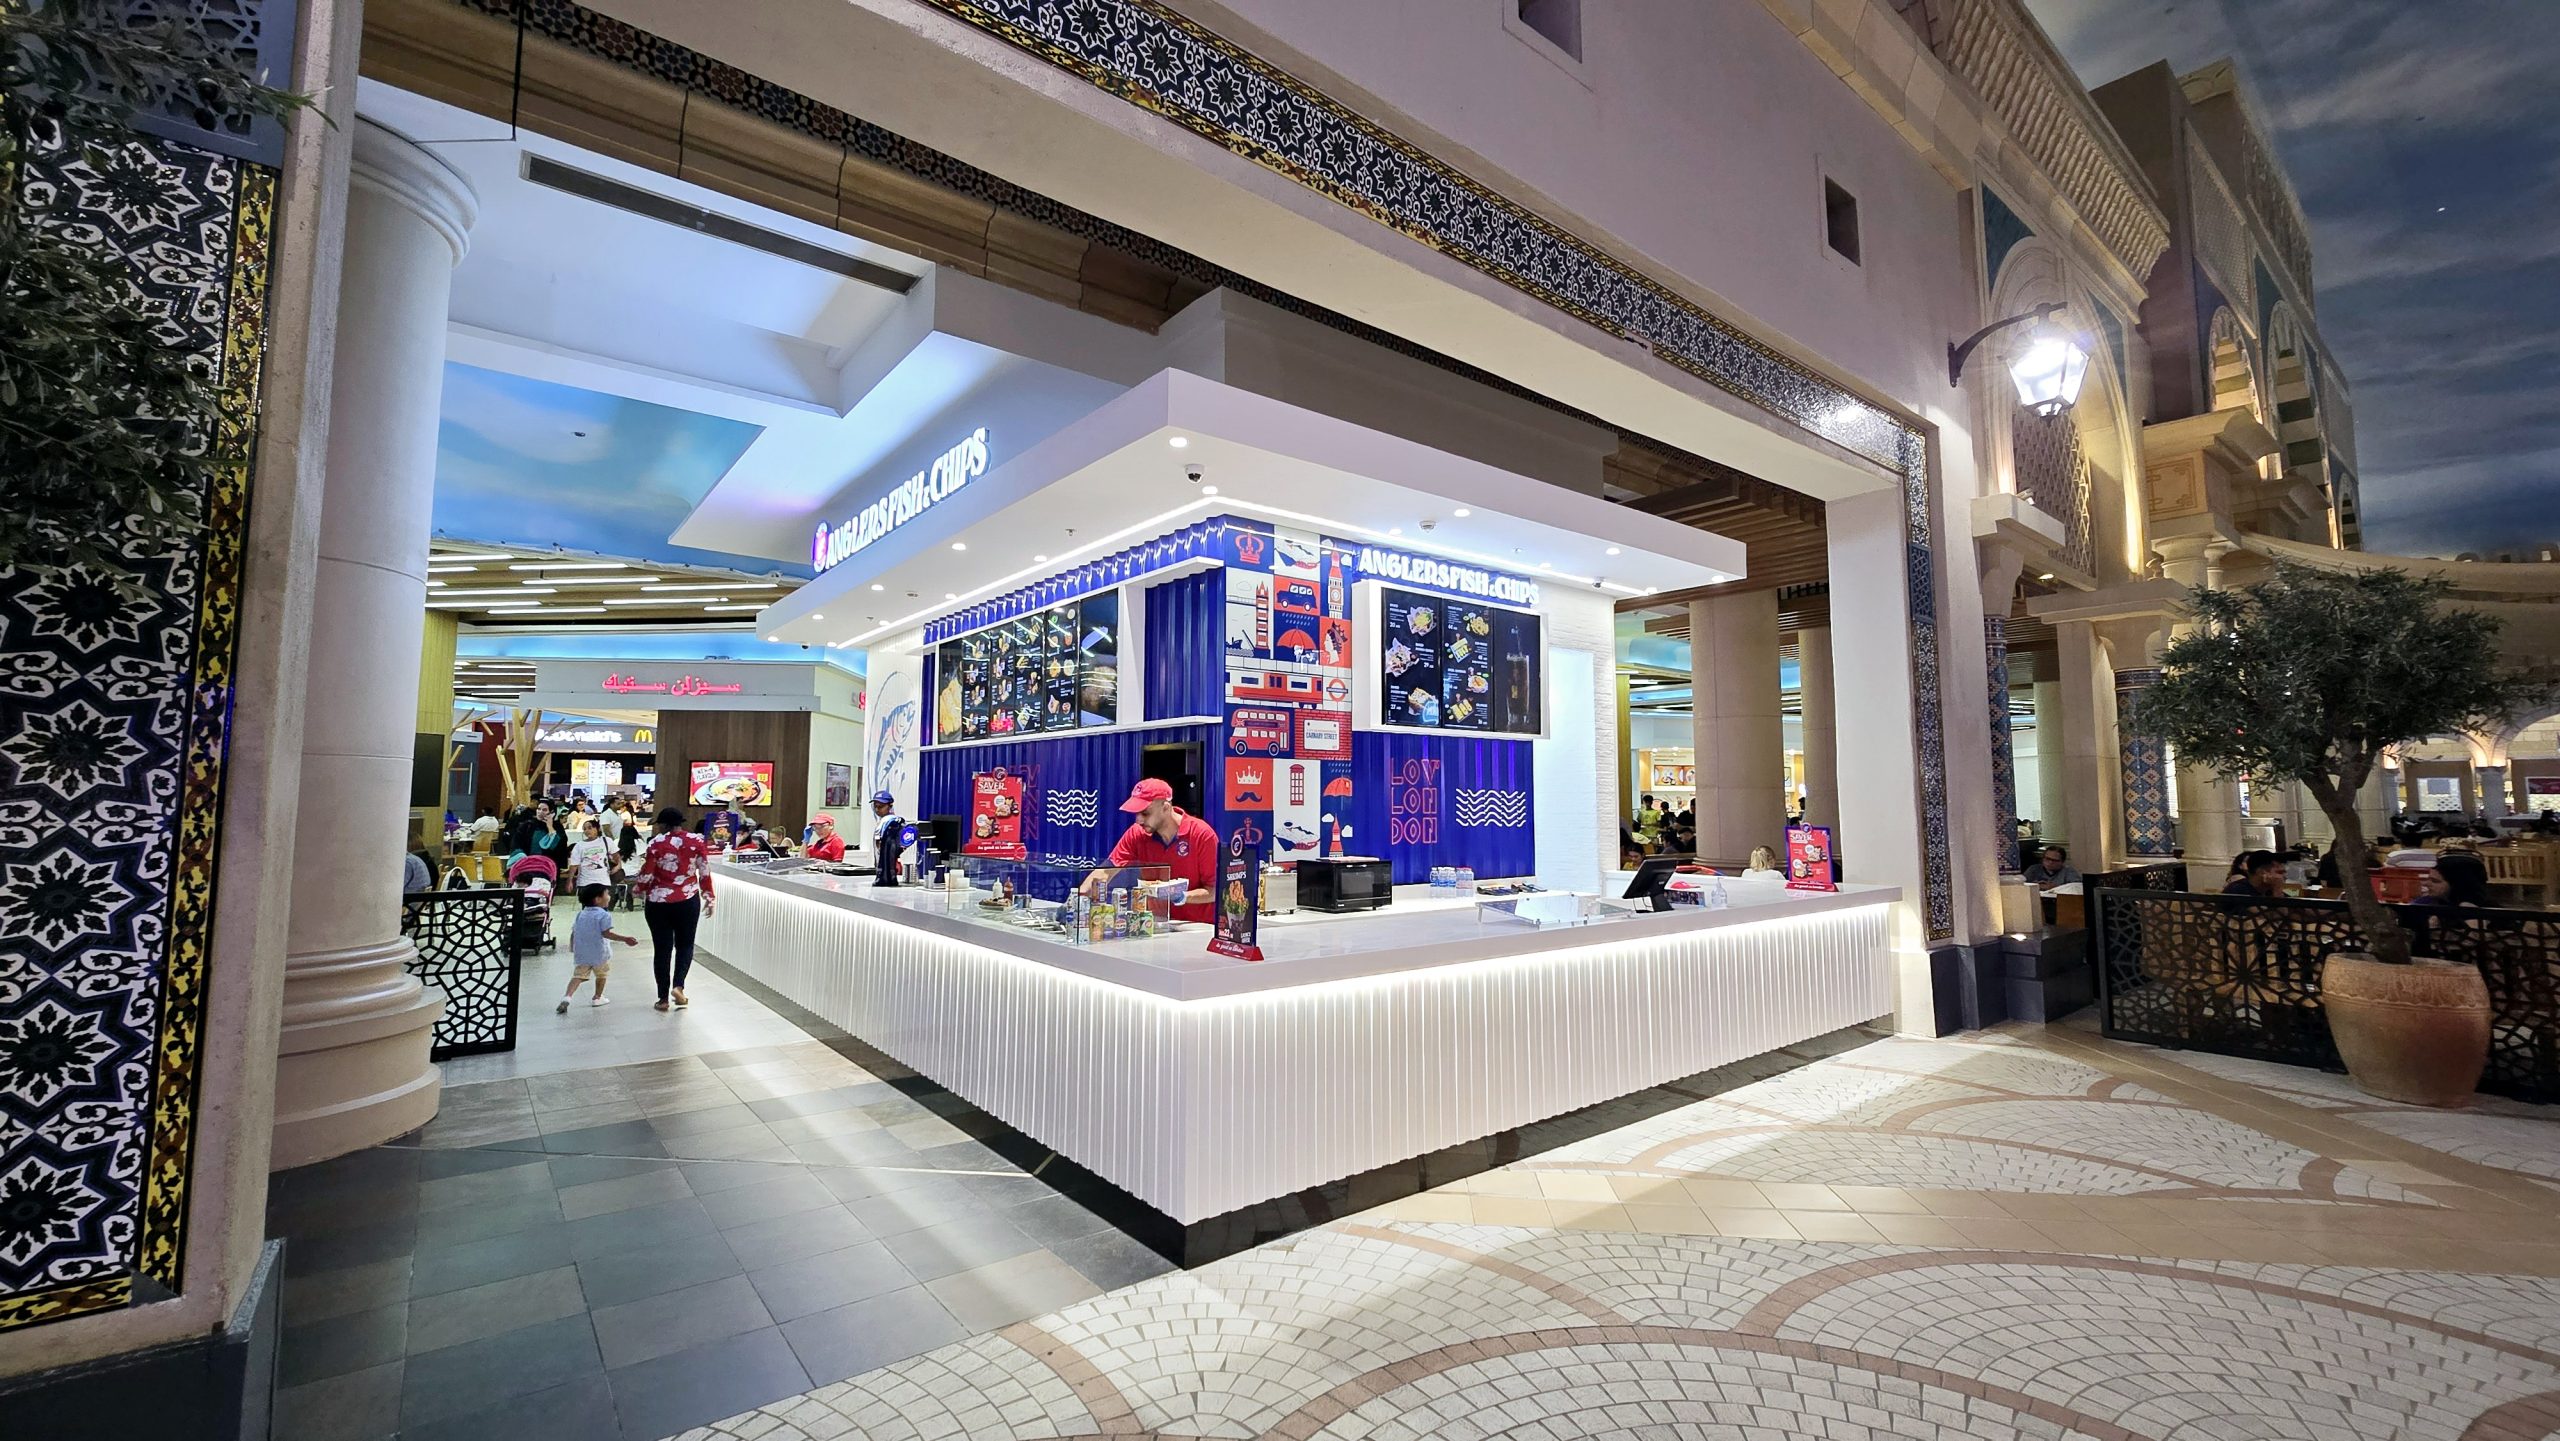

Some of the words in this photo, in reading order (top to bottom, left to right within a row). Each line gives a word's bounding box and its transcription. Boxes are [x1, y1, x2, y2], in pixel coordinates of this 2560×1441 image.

[826, 496, 889, 570] ANGLERS
[886, 470, 926, 533] FISH
[929, 426, 989, 503] CHIPS
[1358, 548, 1450, 589] ANGLERS
[1449, 566, 1489, 597] FISH
[1494, 576, 1540, 606] CHIPS
